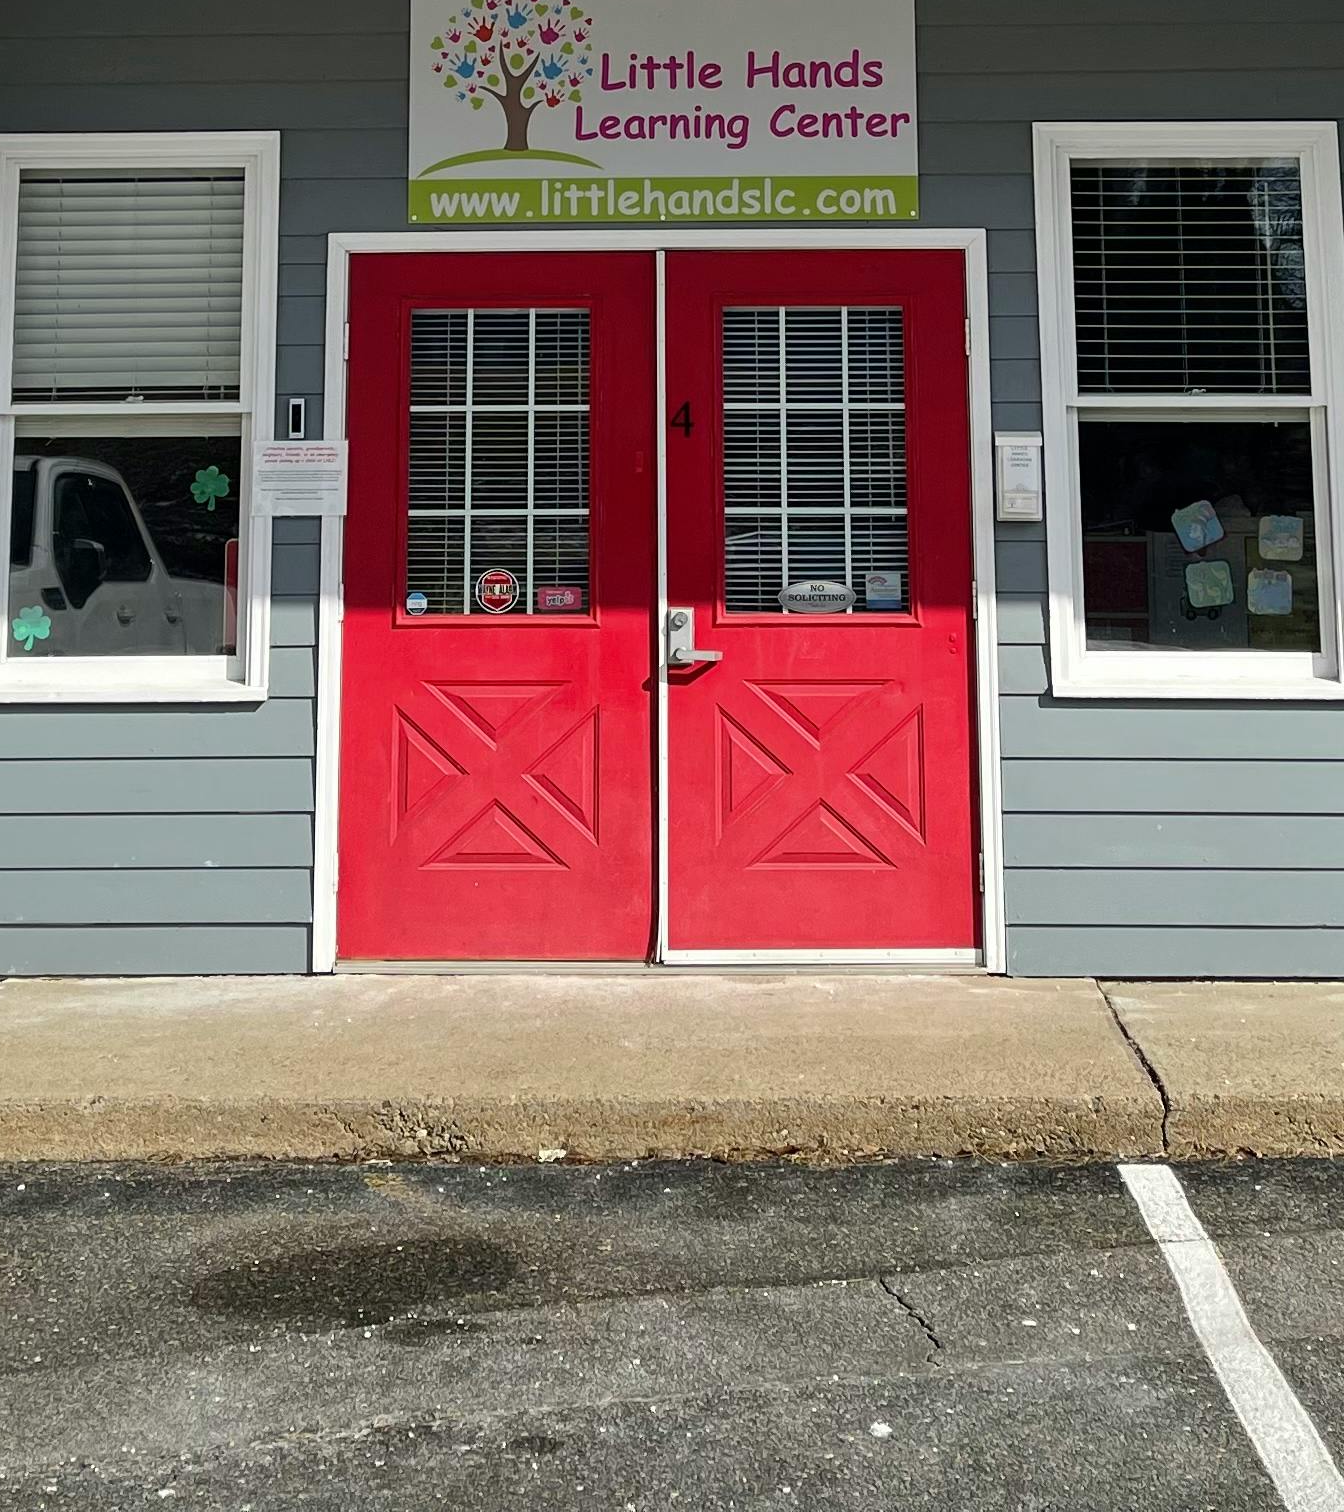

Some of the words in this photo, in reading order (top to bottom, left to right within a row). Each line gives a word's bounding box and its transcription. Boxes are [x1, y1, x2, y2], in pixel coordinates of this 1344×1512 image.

[600, 50, 724, 92] Little
[746, 48, 885, 90] Hands
[574, 104, 752, 150] Learning
[768, 103, 912, 138] Center
[429, 179, 898, 218] www.littlehandslc.com
[670, 400, 695, 439] 4
[787, 593, 846, 602] SOLICITING
[810, 584, 825, 593] NO
